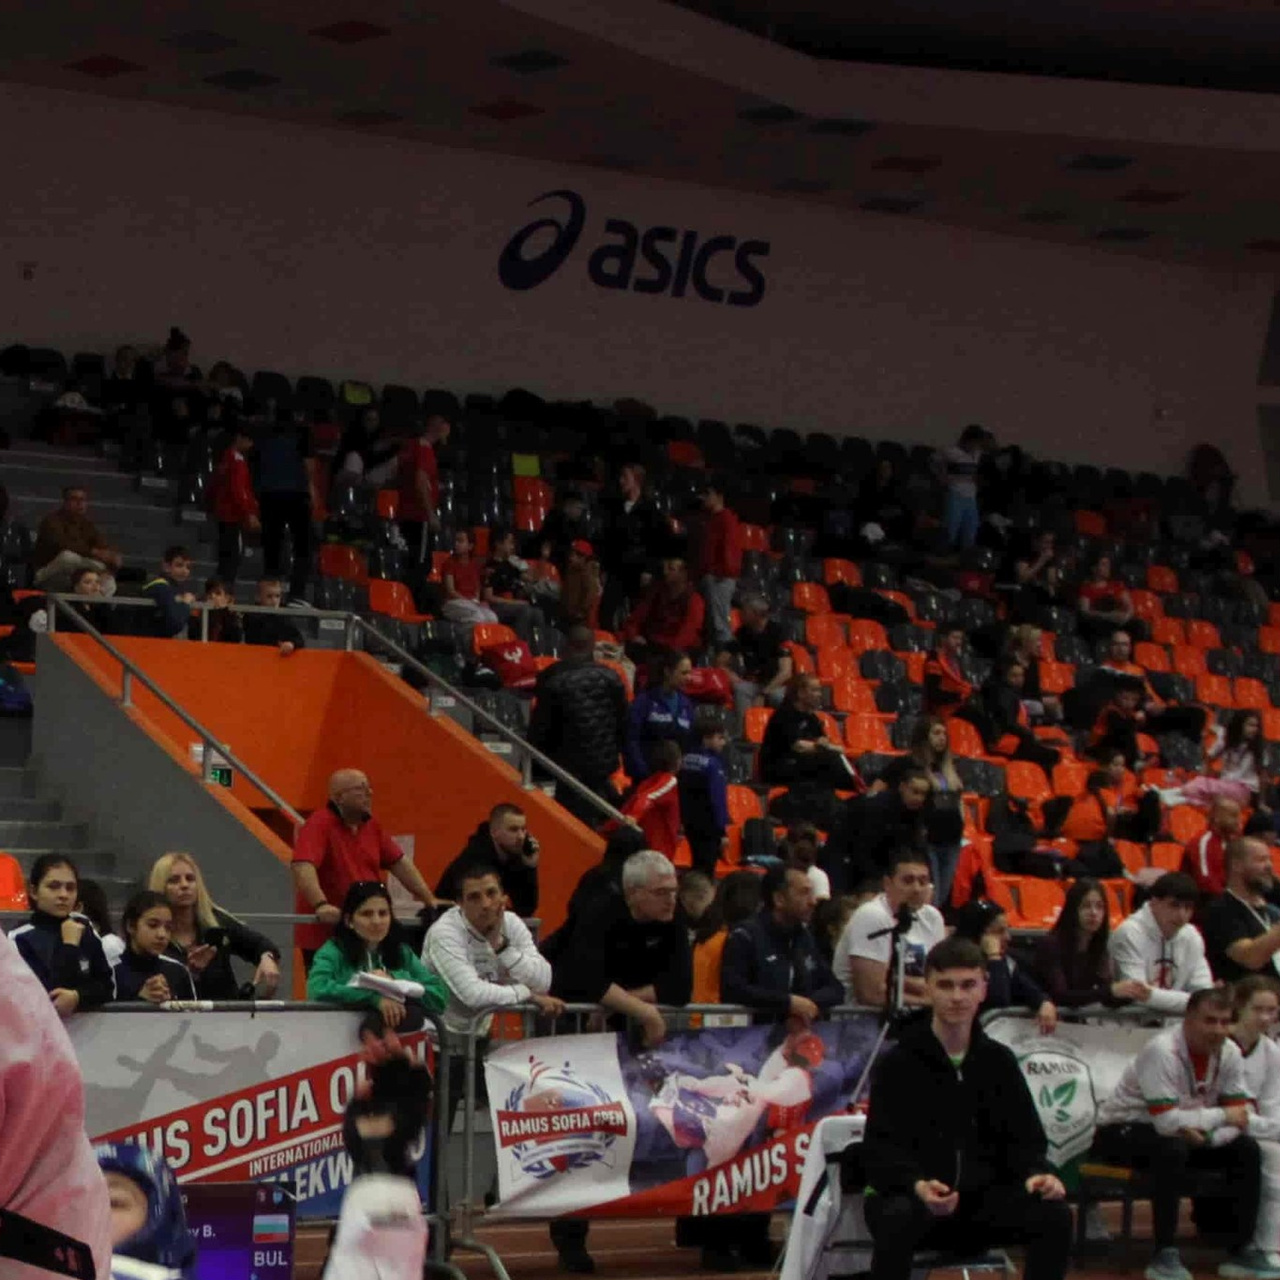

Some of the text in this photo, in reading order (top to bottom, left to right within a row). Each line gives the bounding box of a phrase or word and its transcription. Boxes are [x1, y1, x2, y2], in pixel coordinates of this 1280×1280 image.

[588, 219, 770, 306] asics
[203, 1080, 319, 1158] SOFIA
[500, 1110, 625, 1137] RAMUS SOFIA OPEN
[249, 1132, 345, 1178] INTERNATIONAL
[692, 1143, 788, 1216] RAMUS
[254, 1250, 288, 1267] BUL
